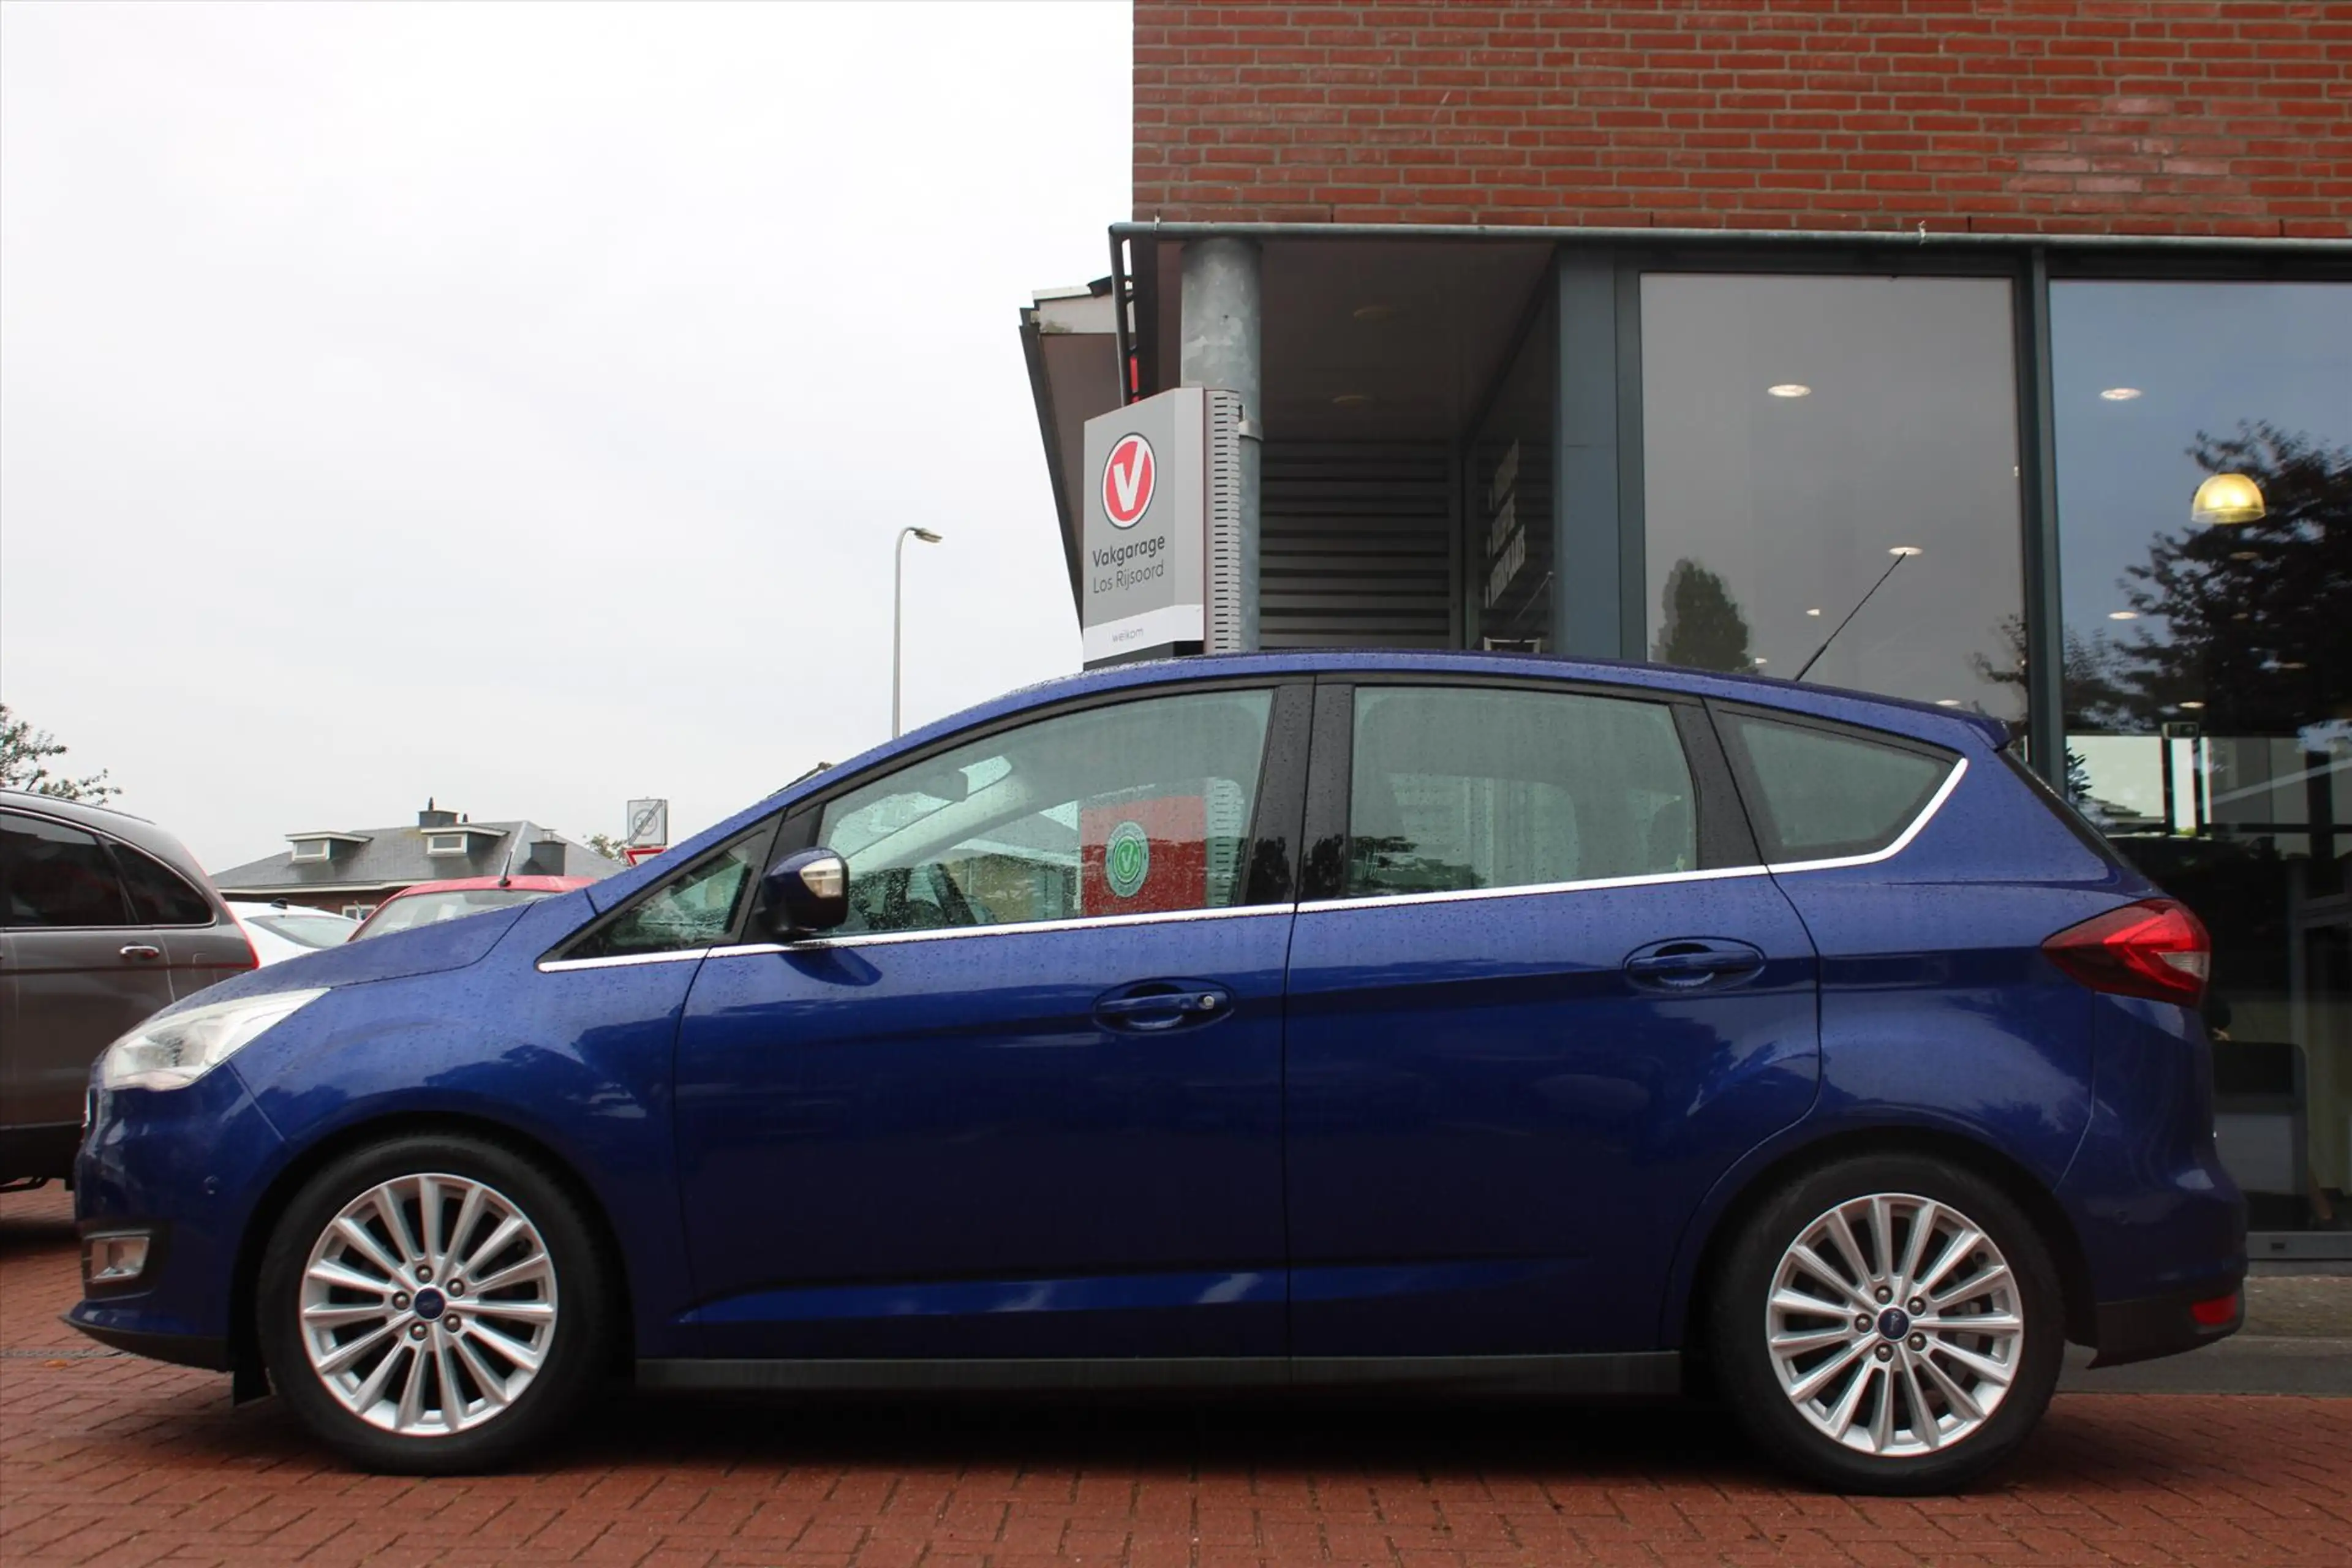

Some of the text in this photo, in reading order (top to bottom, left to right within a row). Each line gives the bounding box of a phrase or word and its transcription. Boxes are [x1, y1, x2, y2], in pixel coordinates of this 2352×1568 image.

[1093, 535, 1165, 567] Vakgarage
[1093, 559, 1164, 594] Los Rijsoord
